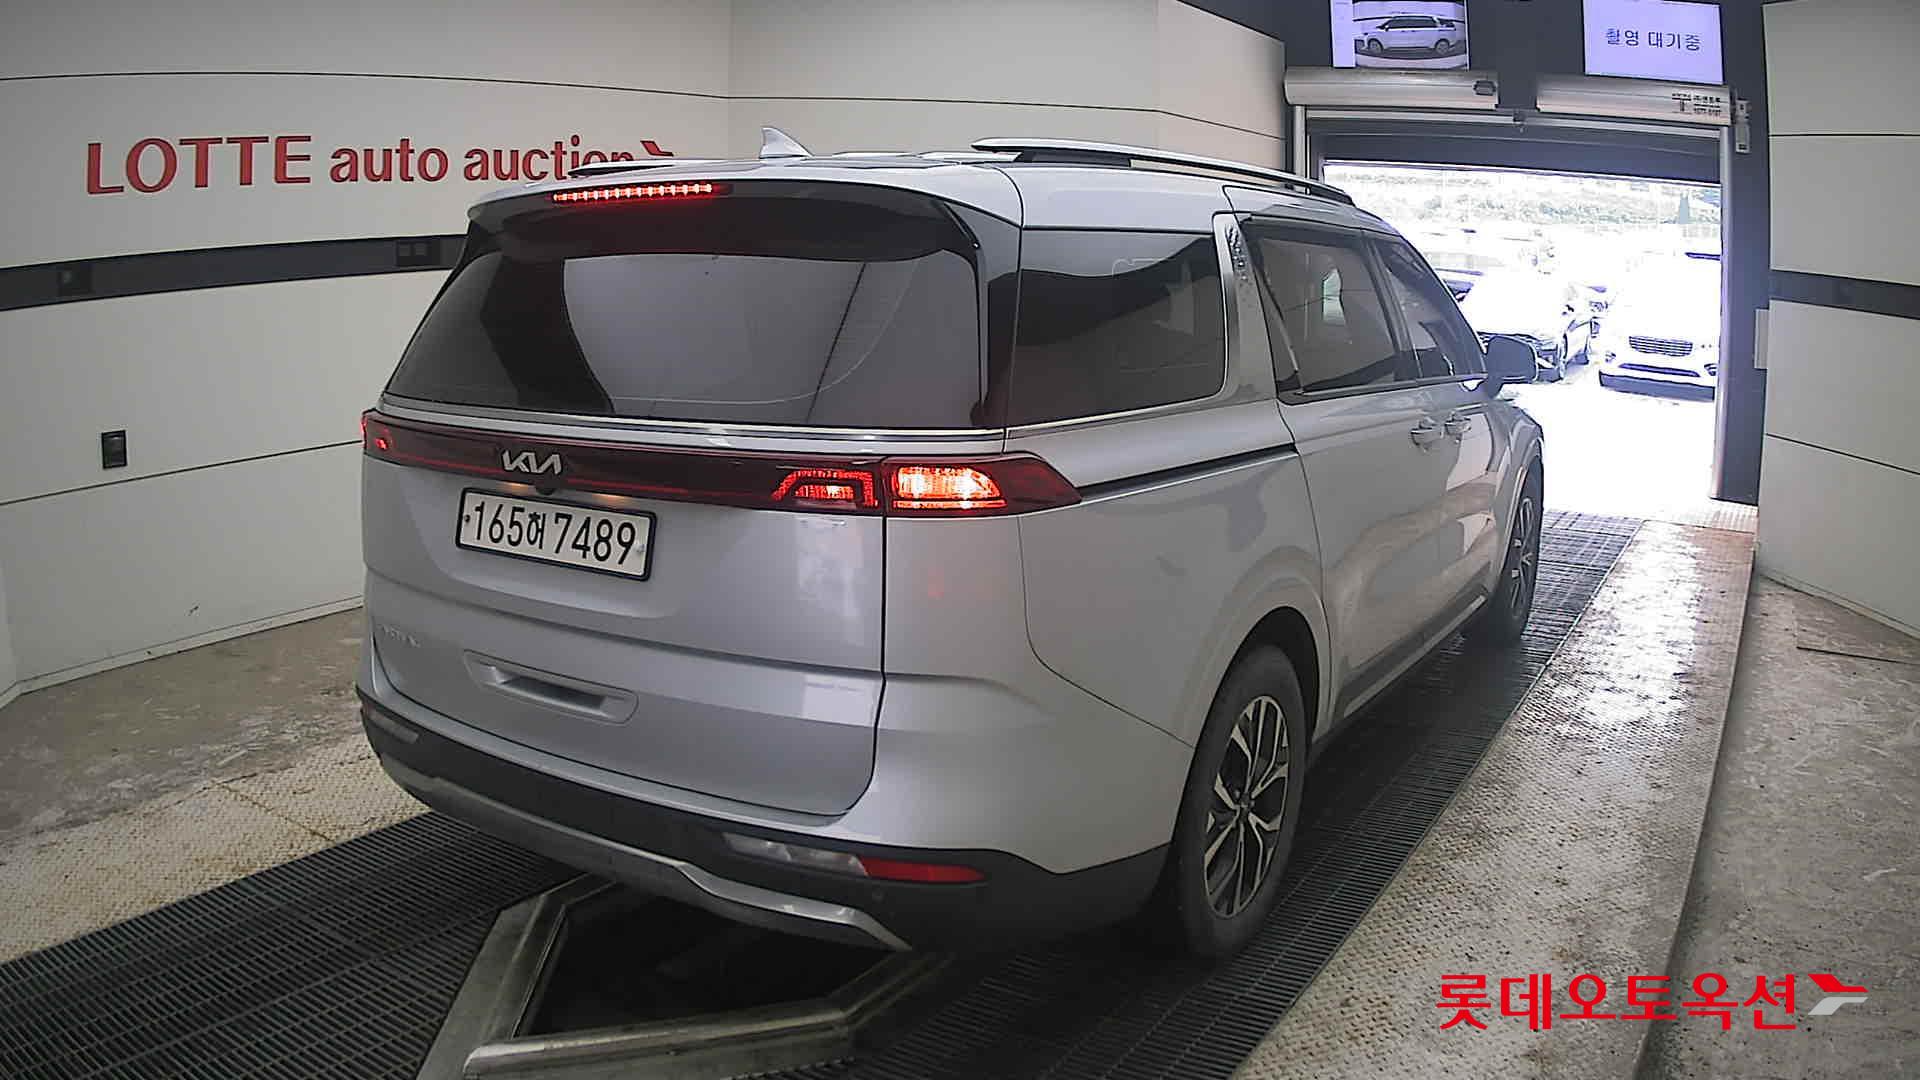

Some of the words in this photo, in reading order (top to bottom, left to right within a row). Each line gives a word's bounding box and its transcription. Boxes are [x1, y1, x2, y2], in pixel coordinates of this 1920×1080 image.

[1648, 31, 1700, 51] 대기중
[88, 135, 312, 194] LOTTE
[330, 138, 449, 182] auto
[502, 450, 562, 475] KIA
[475, 501, 546, 549] 165허
[554, 512, 636, 565] 7489
